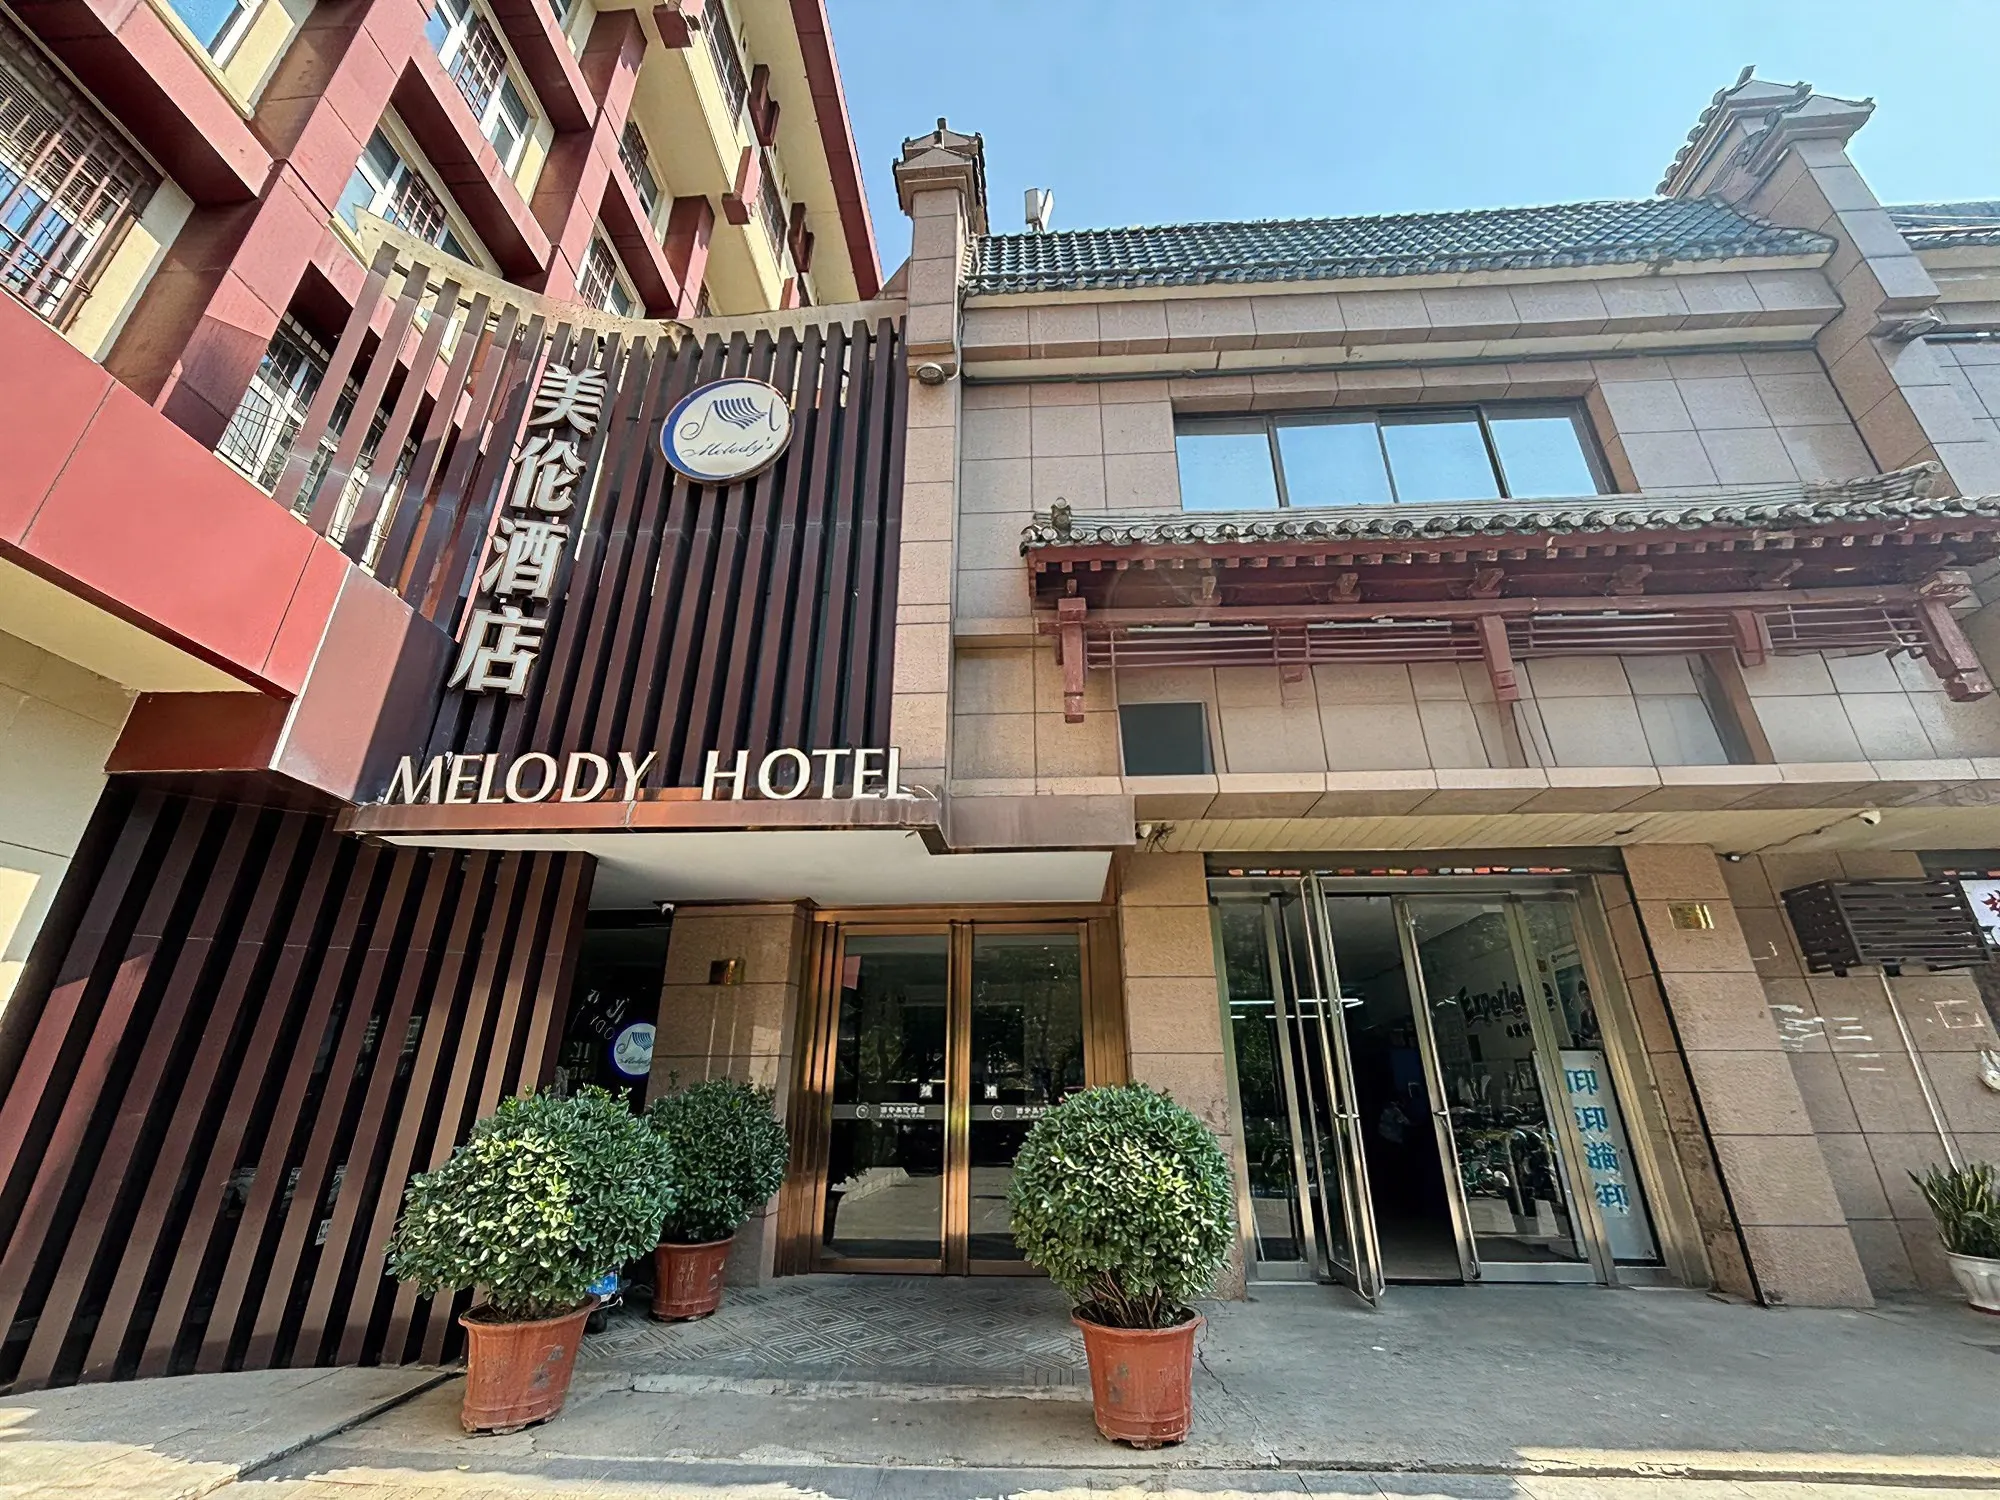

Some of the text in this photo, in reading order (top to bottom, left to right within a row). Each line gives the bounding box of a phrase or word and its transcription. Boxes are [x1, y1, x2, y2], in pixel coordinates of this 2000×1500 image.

[449, 363, 609, 699] 美伦酒店
[382, 746, 917, 806] MELODY HOTEL
